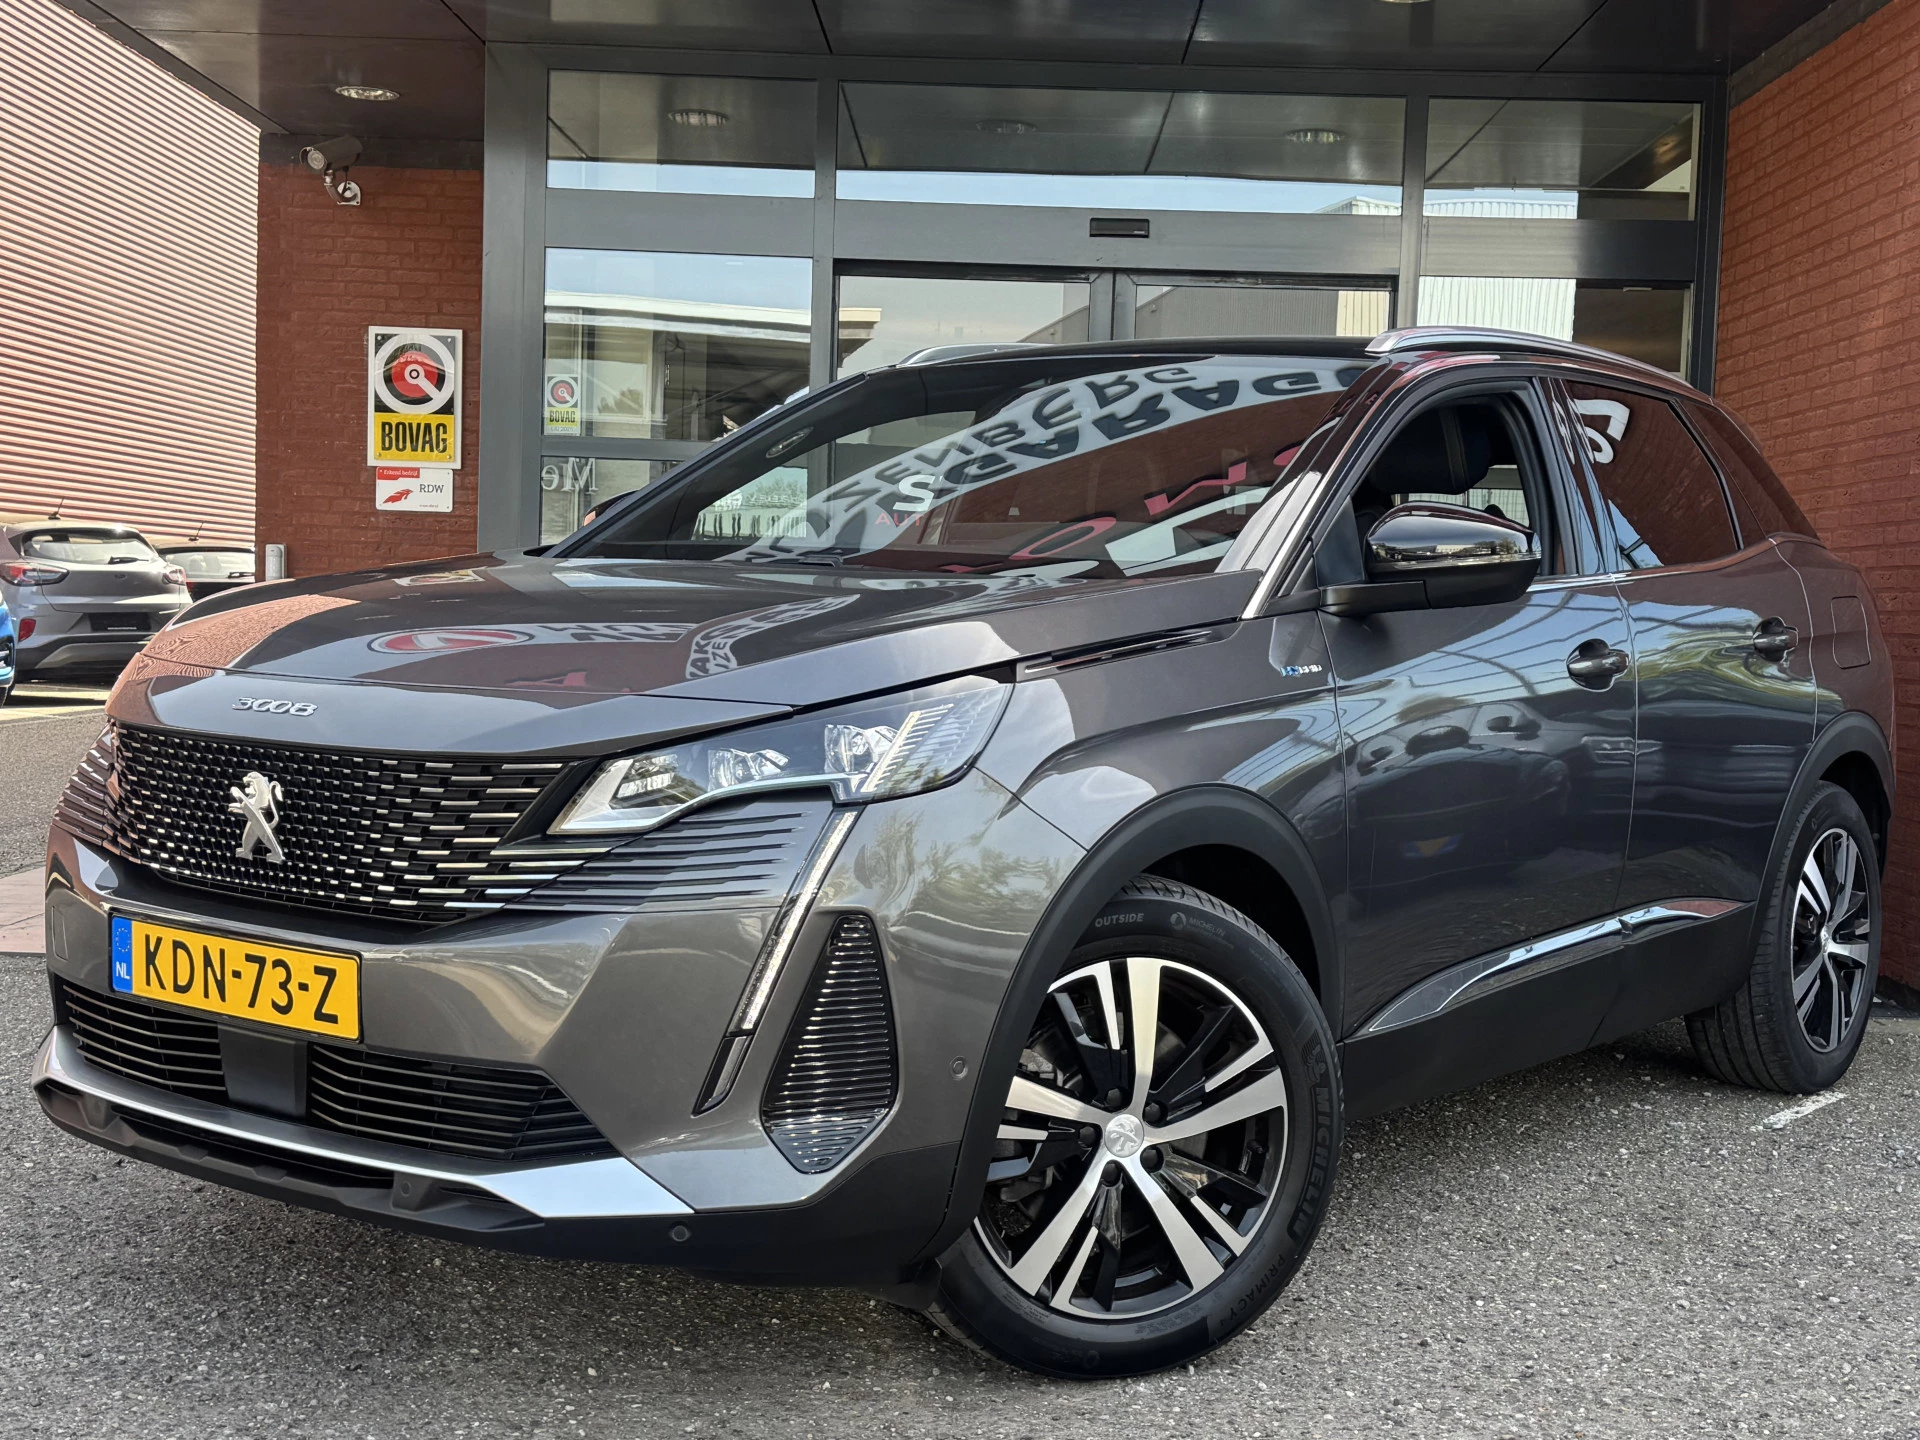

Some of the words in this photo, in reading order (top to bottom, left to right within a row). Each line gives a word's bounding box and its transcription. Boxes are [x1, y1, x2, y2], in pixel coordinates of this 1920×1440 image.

[549, 410, 576, 423] BOVAG
[381, 421, 448, 453] BOVAG
[419, 484, 444, 493] RDW
[232, 698, 318, 716] 3008
[1095, 913, 1144, 928] OUTSIDE
[116, 961, 130, 980] NL
[144, 933, 339, 1025] KDN-73-Z
[1293, 1087, 1332, 1237] MICHELIN
[1229, 1254, 1286, 1320] PRIMACY
